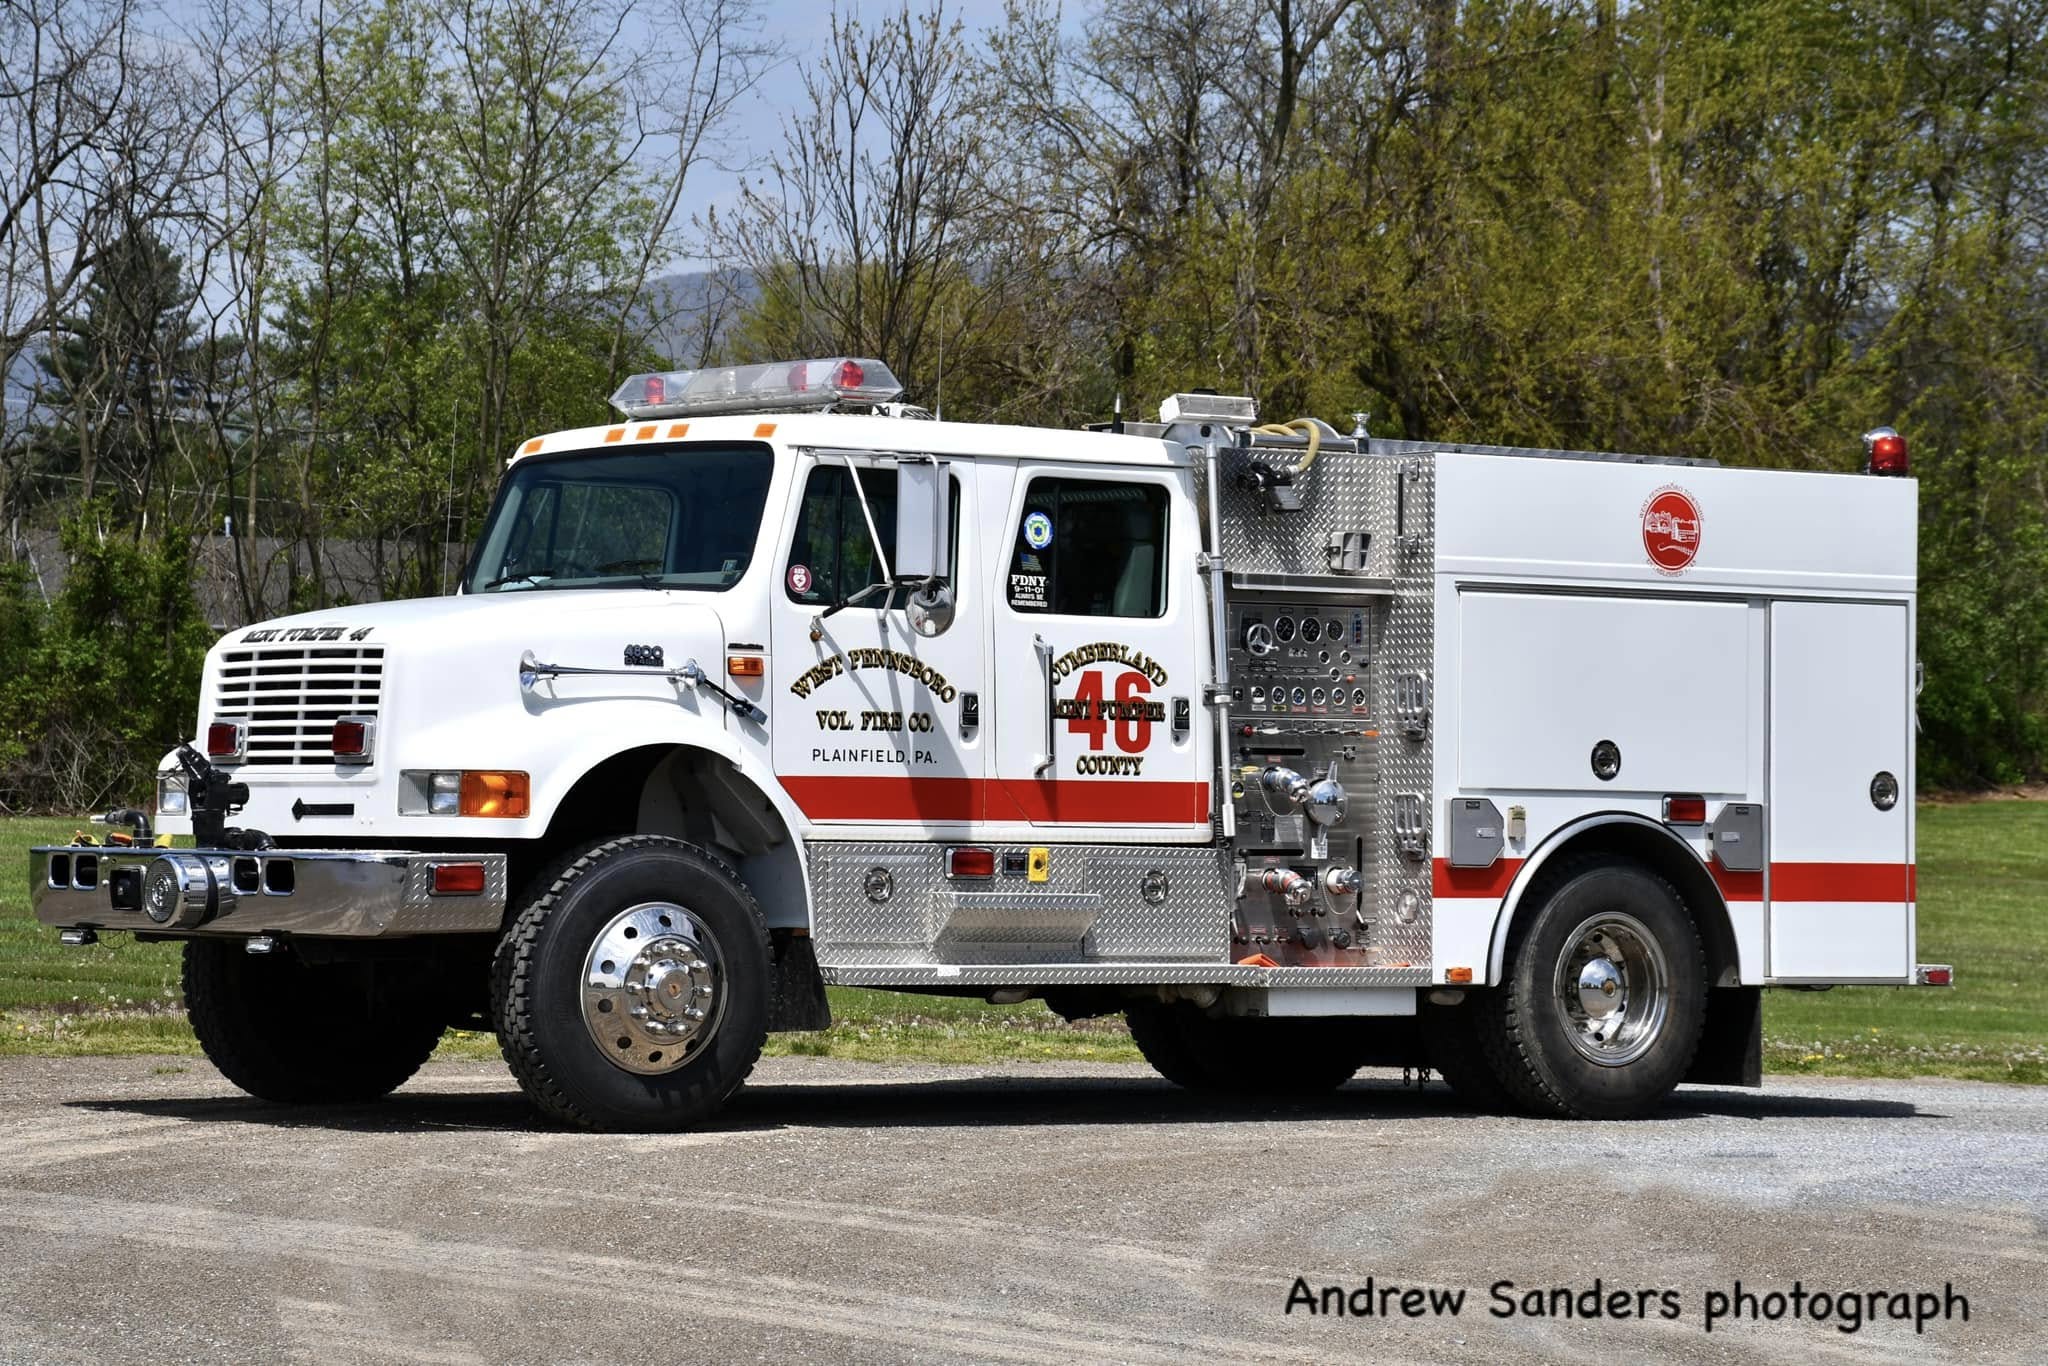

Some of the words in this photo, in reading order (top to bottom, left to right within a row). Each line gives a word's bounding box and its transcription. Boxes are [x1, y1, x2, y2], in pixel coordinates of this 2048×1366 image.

[1011, 575, 1046, 586] FDNY
[1014, 586, 1044, 594] 9-11-01
[279, 627, 348, 642] PUMPER
[790, 654, 843, 700] WEST
[848, 648, 956, 703] PENNSBORO
[860, 711, 903, 732] FIRE
[908, 712, 934, 733] CO.
[1068, 670, 1151, 754] 46
[1097, 701, 1166, 723] PUMPER
[812, 748, 911, 765] PLAINFIELD,
[914, 750, 937, 765] PA.
[1076, 756, 1144, 776] COUNTY
